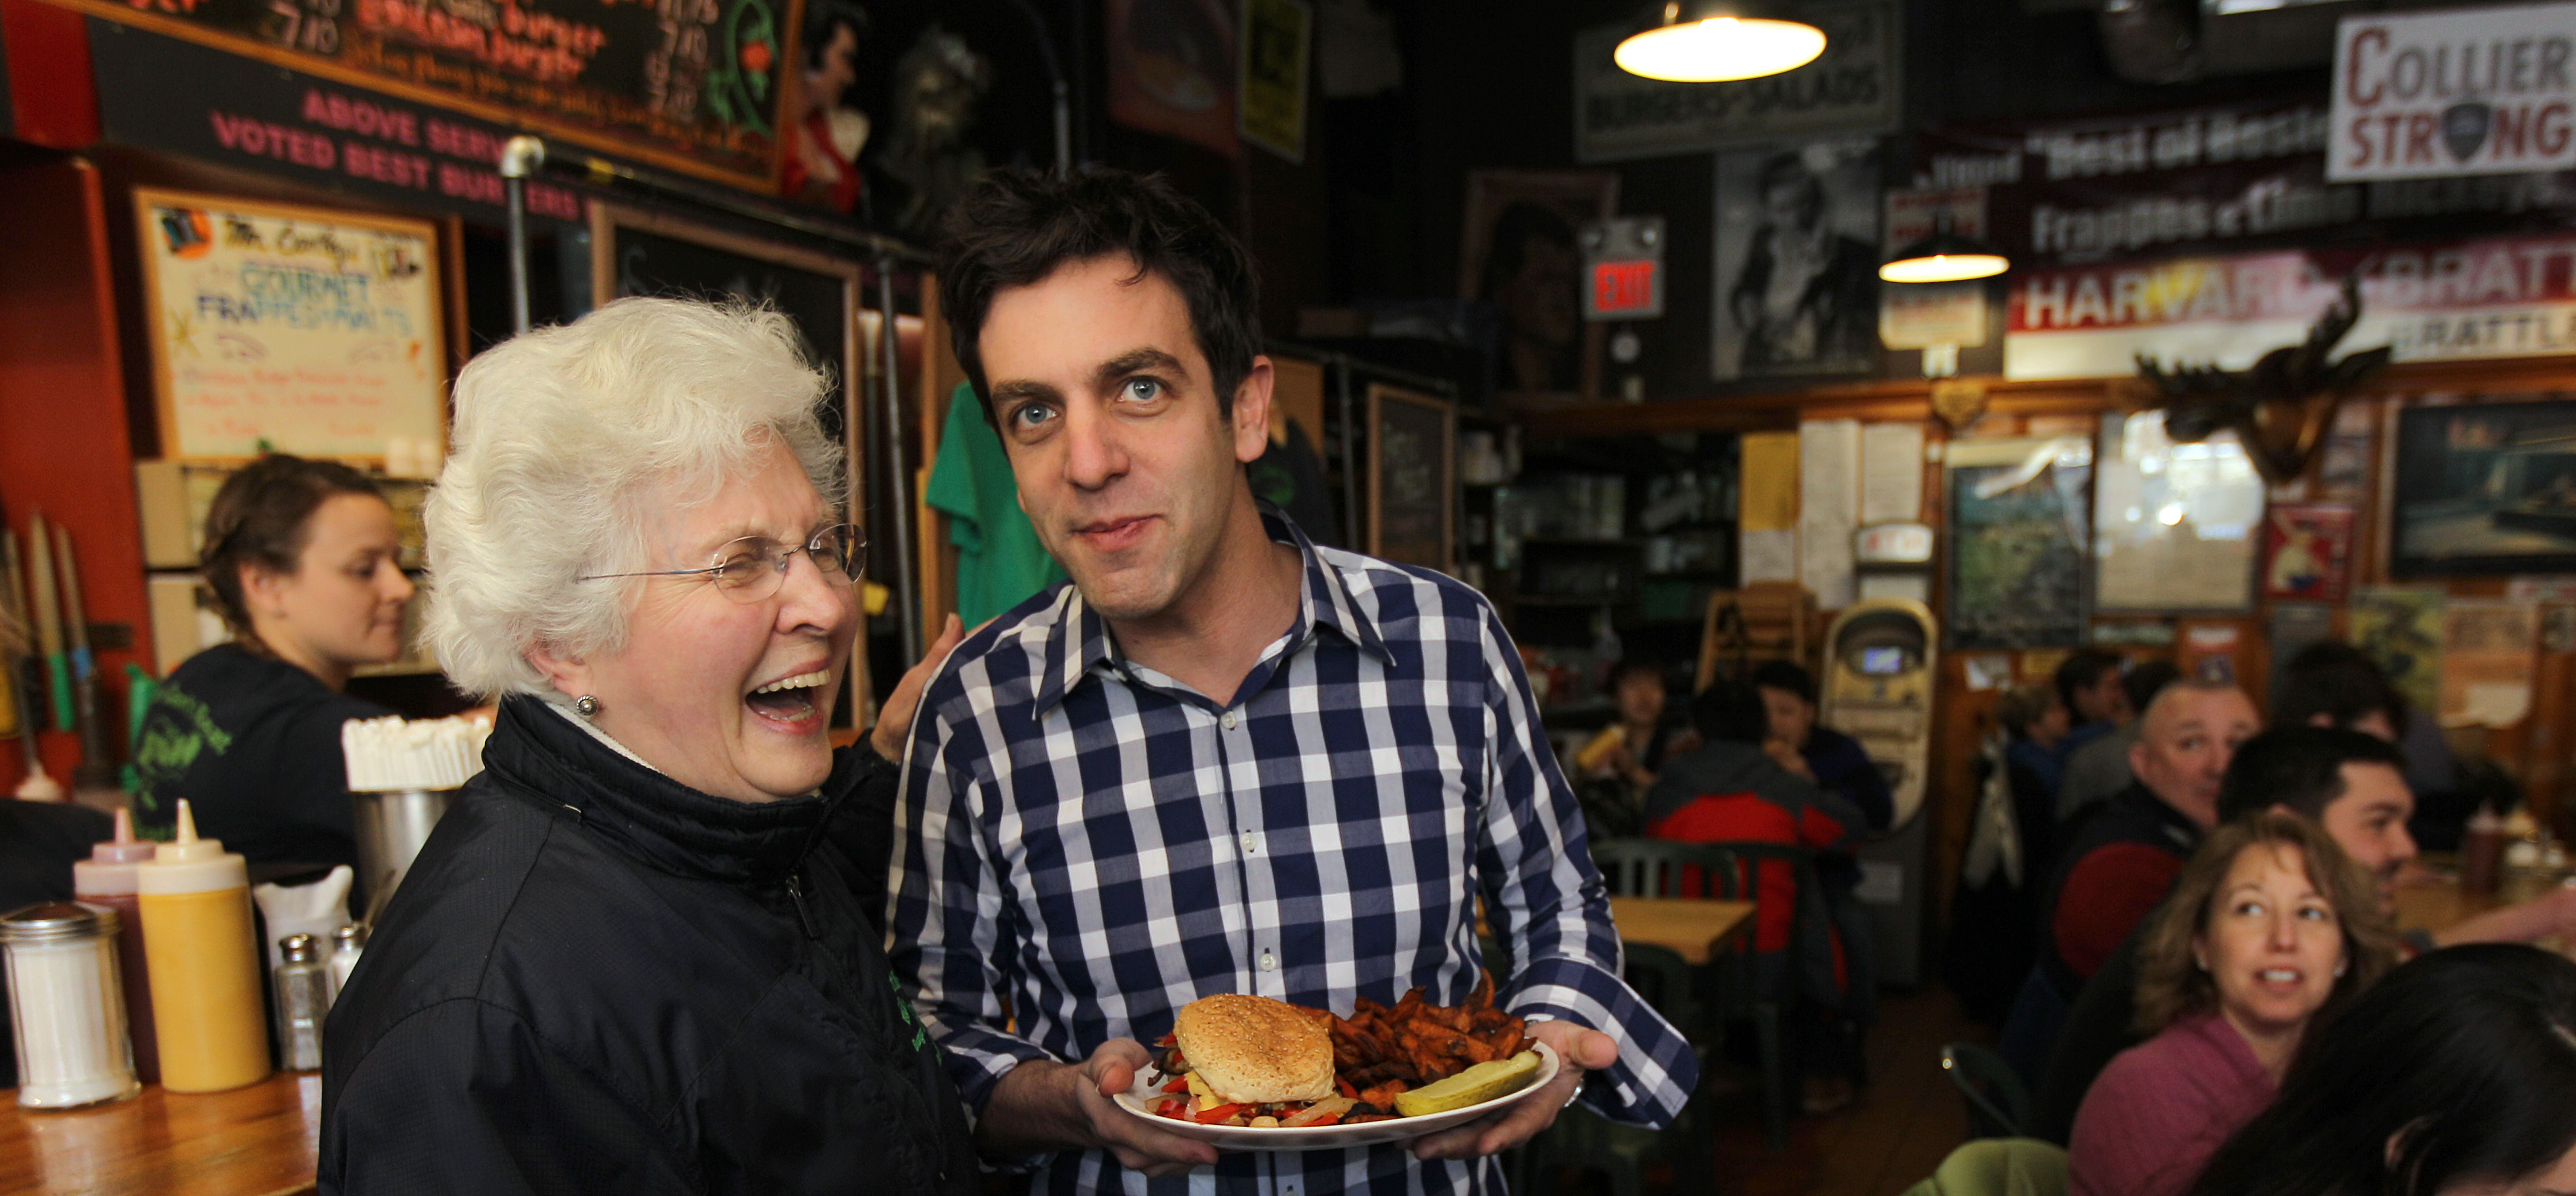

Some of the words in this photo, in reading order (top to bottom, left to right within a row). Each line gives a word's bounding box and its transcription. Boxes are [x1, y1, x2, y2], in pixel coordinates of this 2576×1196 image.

[1748, 64, 1882, 113] SALADS
[2348, 27, 2570, 107] COLLIER
[302, 88, 420, 148] ABOVE
[2151, 111, 2203, 170] of
[209, 109, 337, 170] VOTED
[343, 141, 431, 190] BEST
[439, 162, 579, 221] BURERS
[2031, 194, 2211, 255] Frappes
[241, 261, 368, 305] GOURMET
[1594, 260, 1656, 312] EXIT
[2024, 255, 2325, 331] HARVARD
